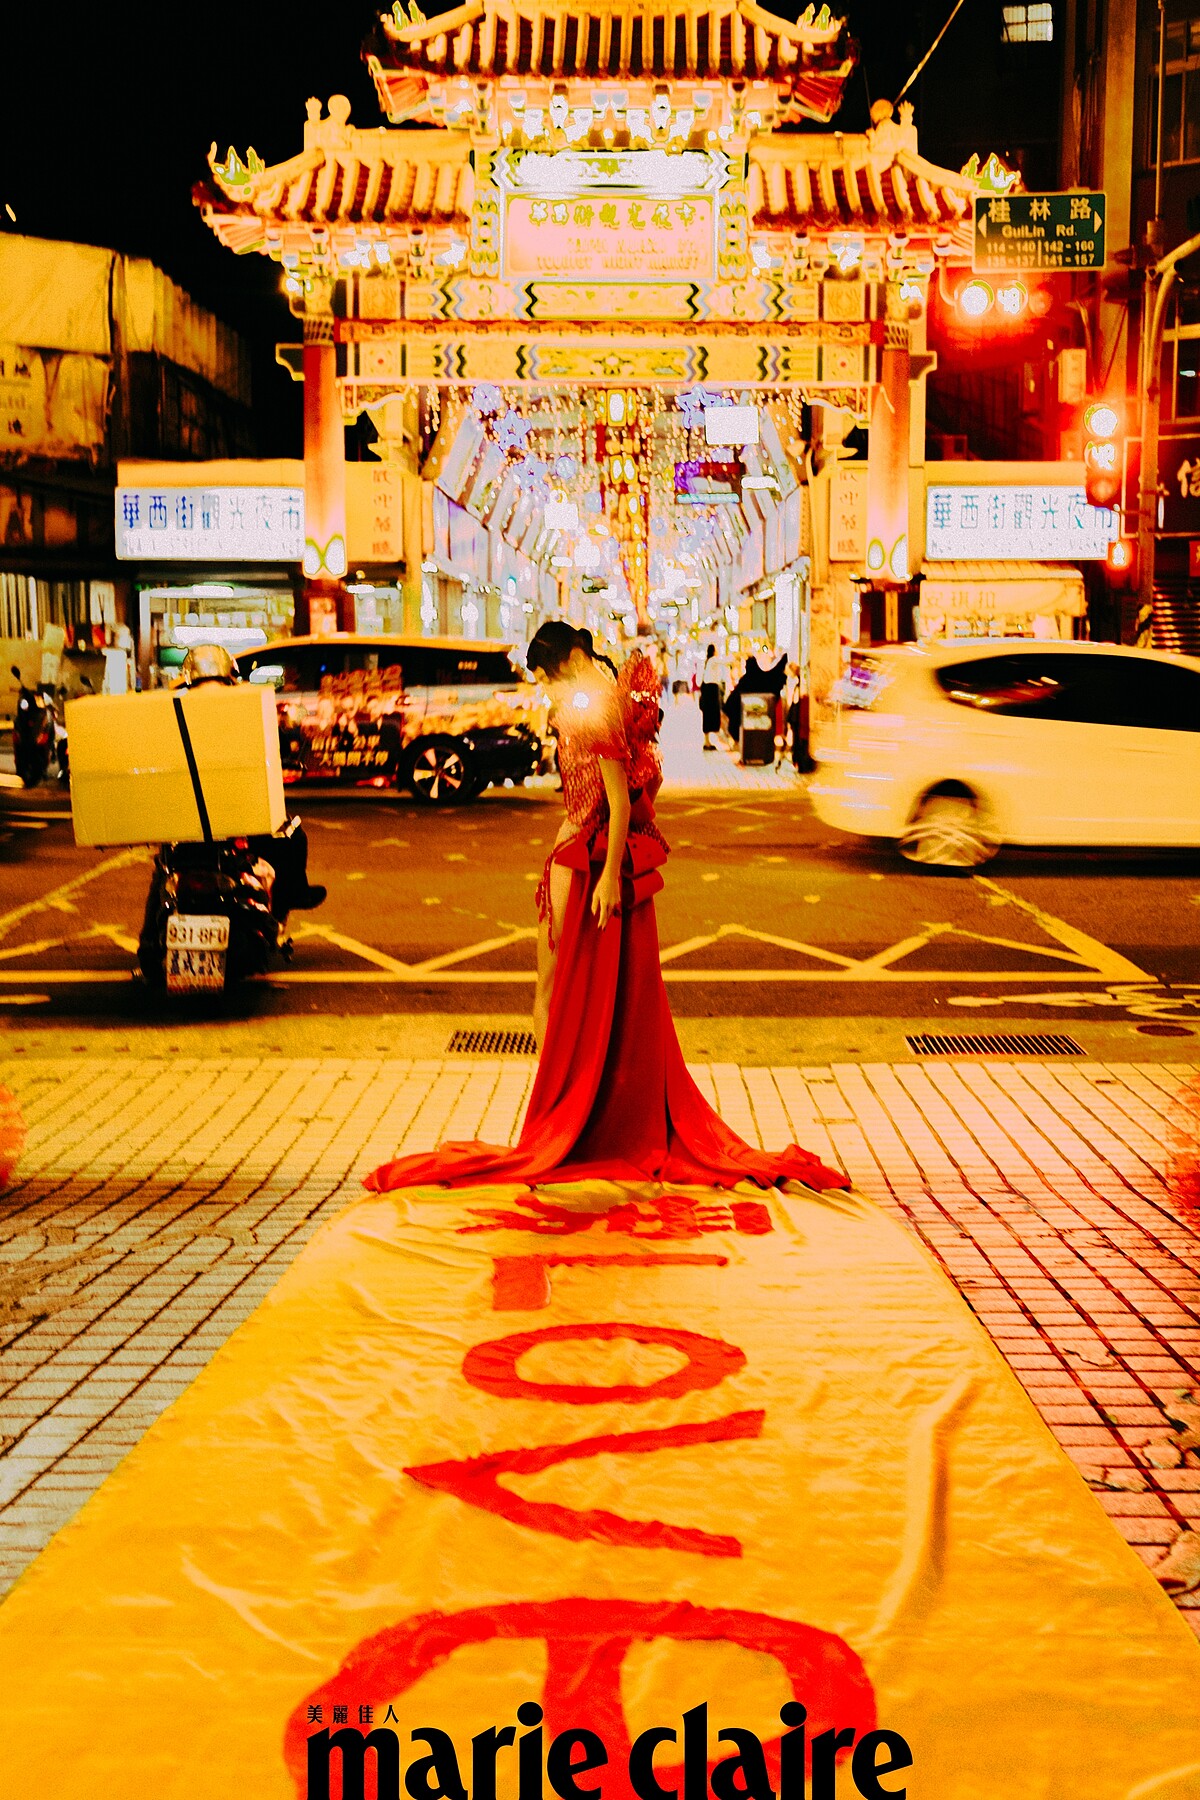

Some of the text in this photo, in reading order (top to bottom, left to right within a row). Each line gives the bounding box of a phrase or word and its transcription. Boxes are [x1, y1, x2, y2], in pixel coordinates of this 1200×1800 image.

[988, 197, 1092, 223] 桂林路
[1056, 224, 1078, 237] Rd.
[123, 495, 300, 530] 華西街觀光夜市
[933, 494, 1113, 529] 華西街觀光夜市
